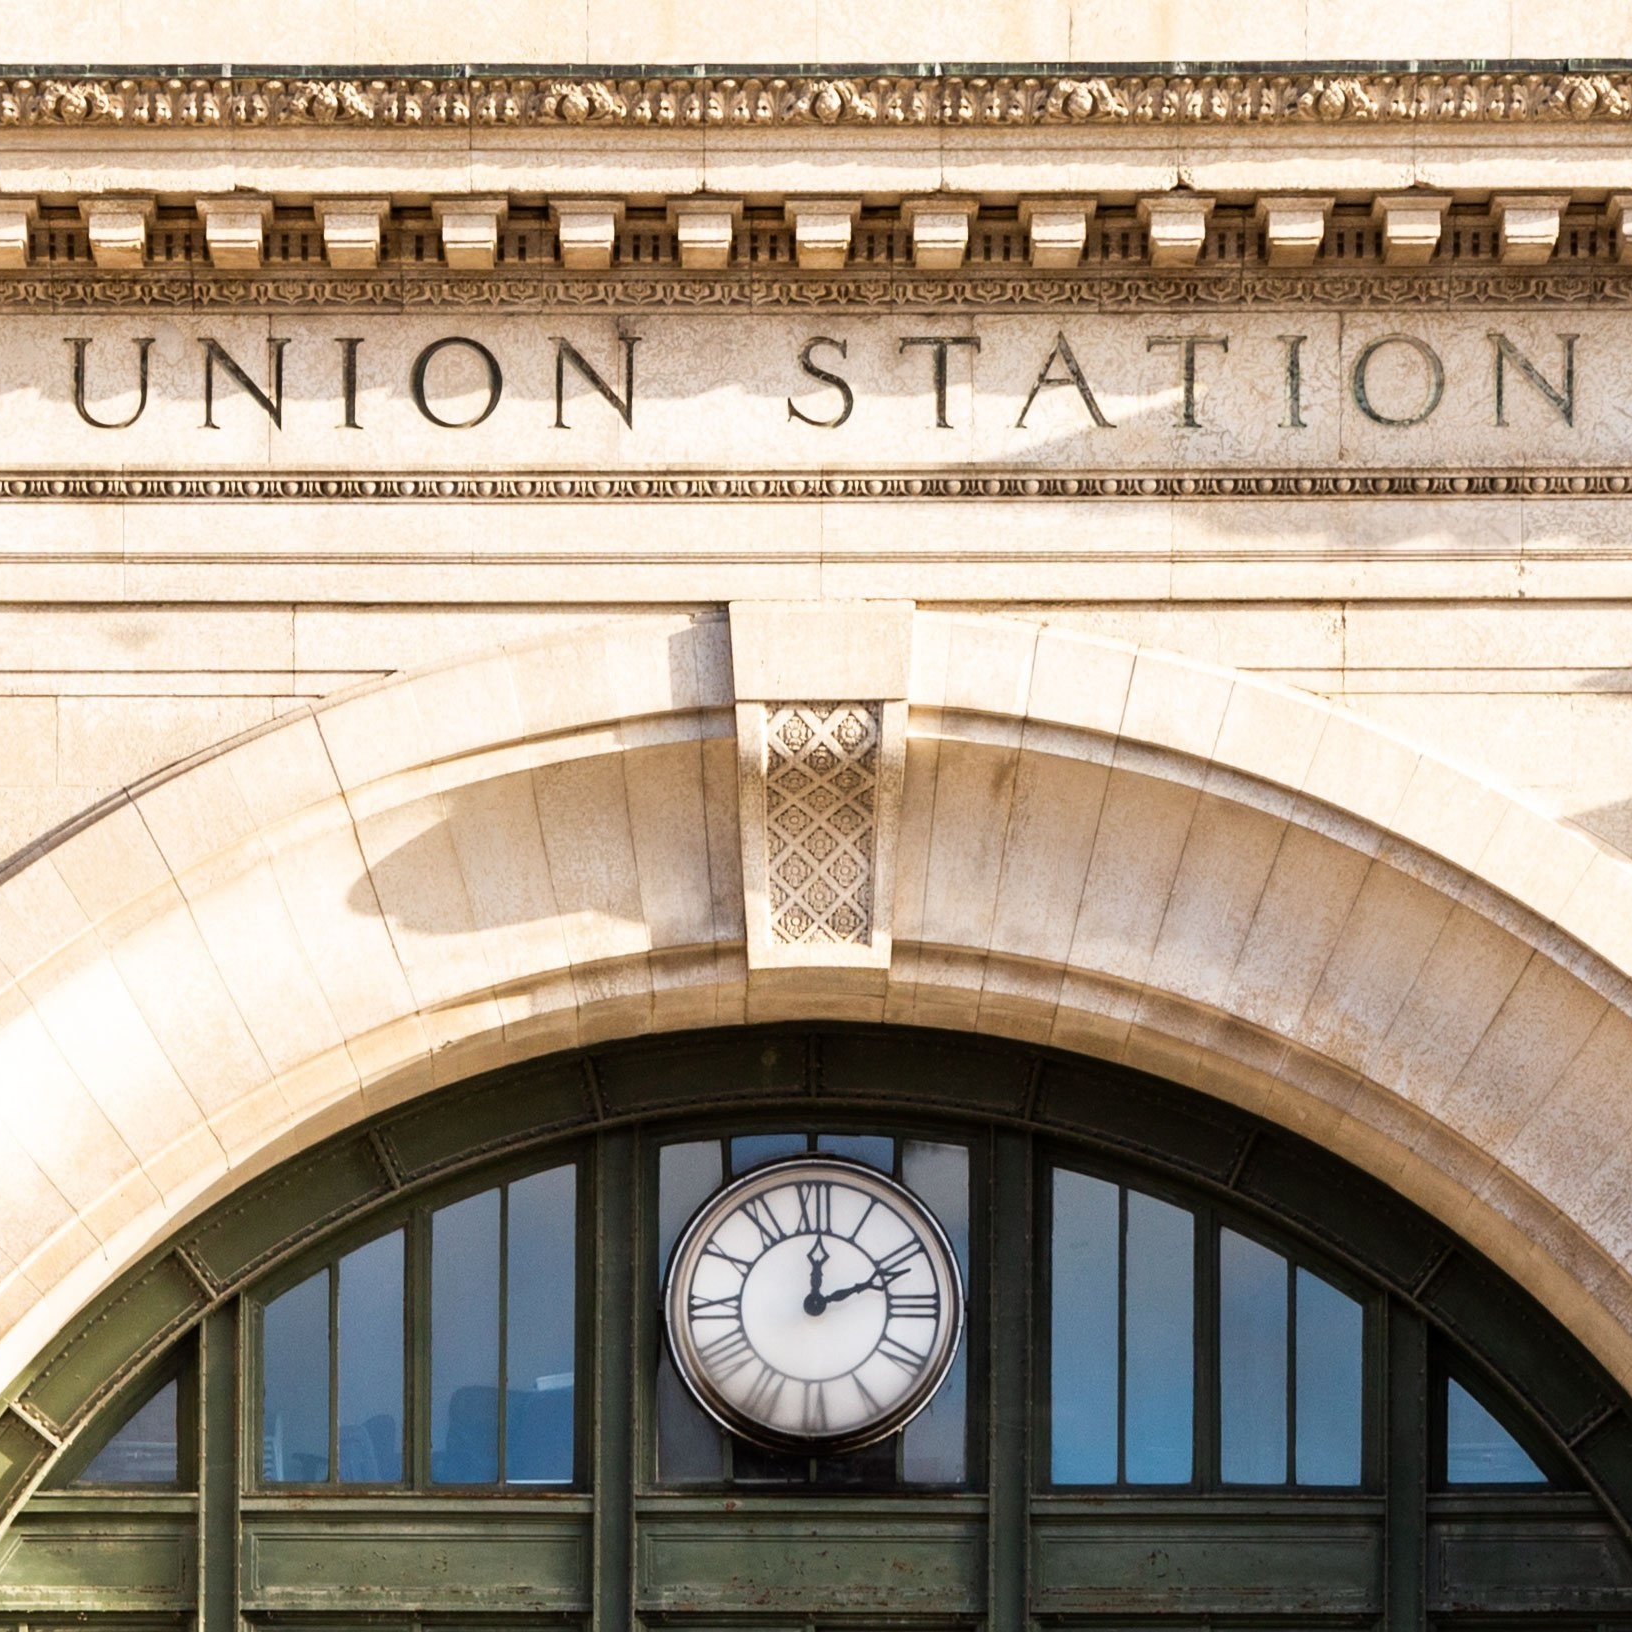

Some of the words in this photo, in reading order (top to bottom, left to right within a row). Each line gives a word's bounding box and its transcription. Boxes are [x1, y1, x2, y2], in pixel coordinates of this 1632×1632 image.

[65, 334, 643, 430] UNION
[784, 332, 1581, 431] STATION
[739, 1196, 787, 1251] XI
[796, 1181, 834, 1234] XII
[702, 1238, 754, 1278] X
[690, 1294, 740, 1320] IX
[888, 1293, 939, 1319] III
